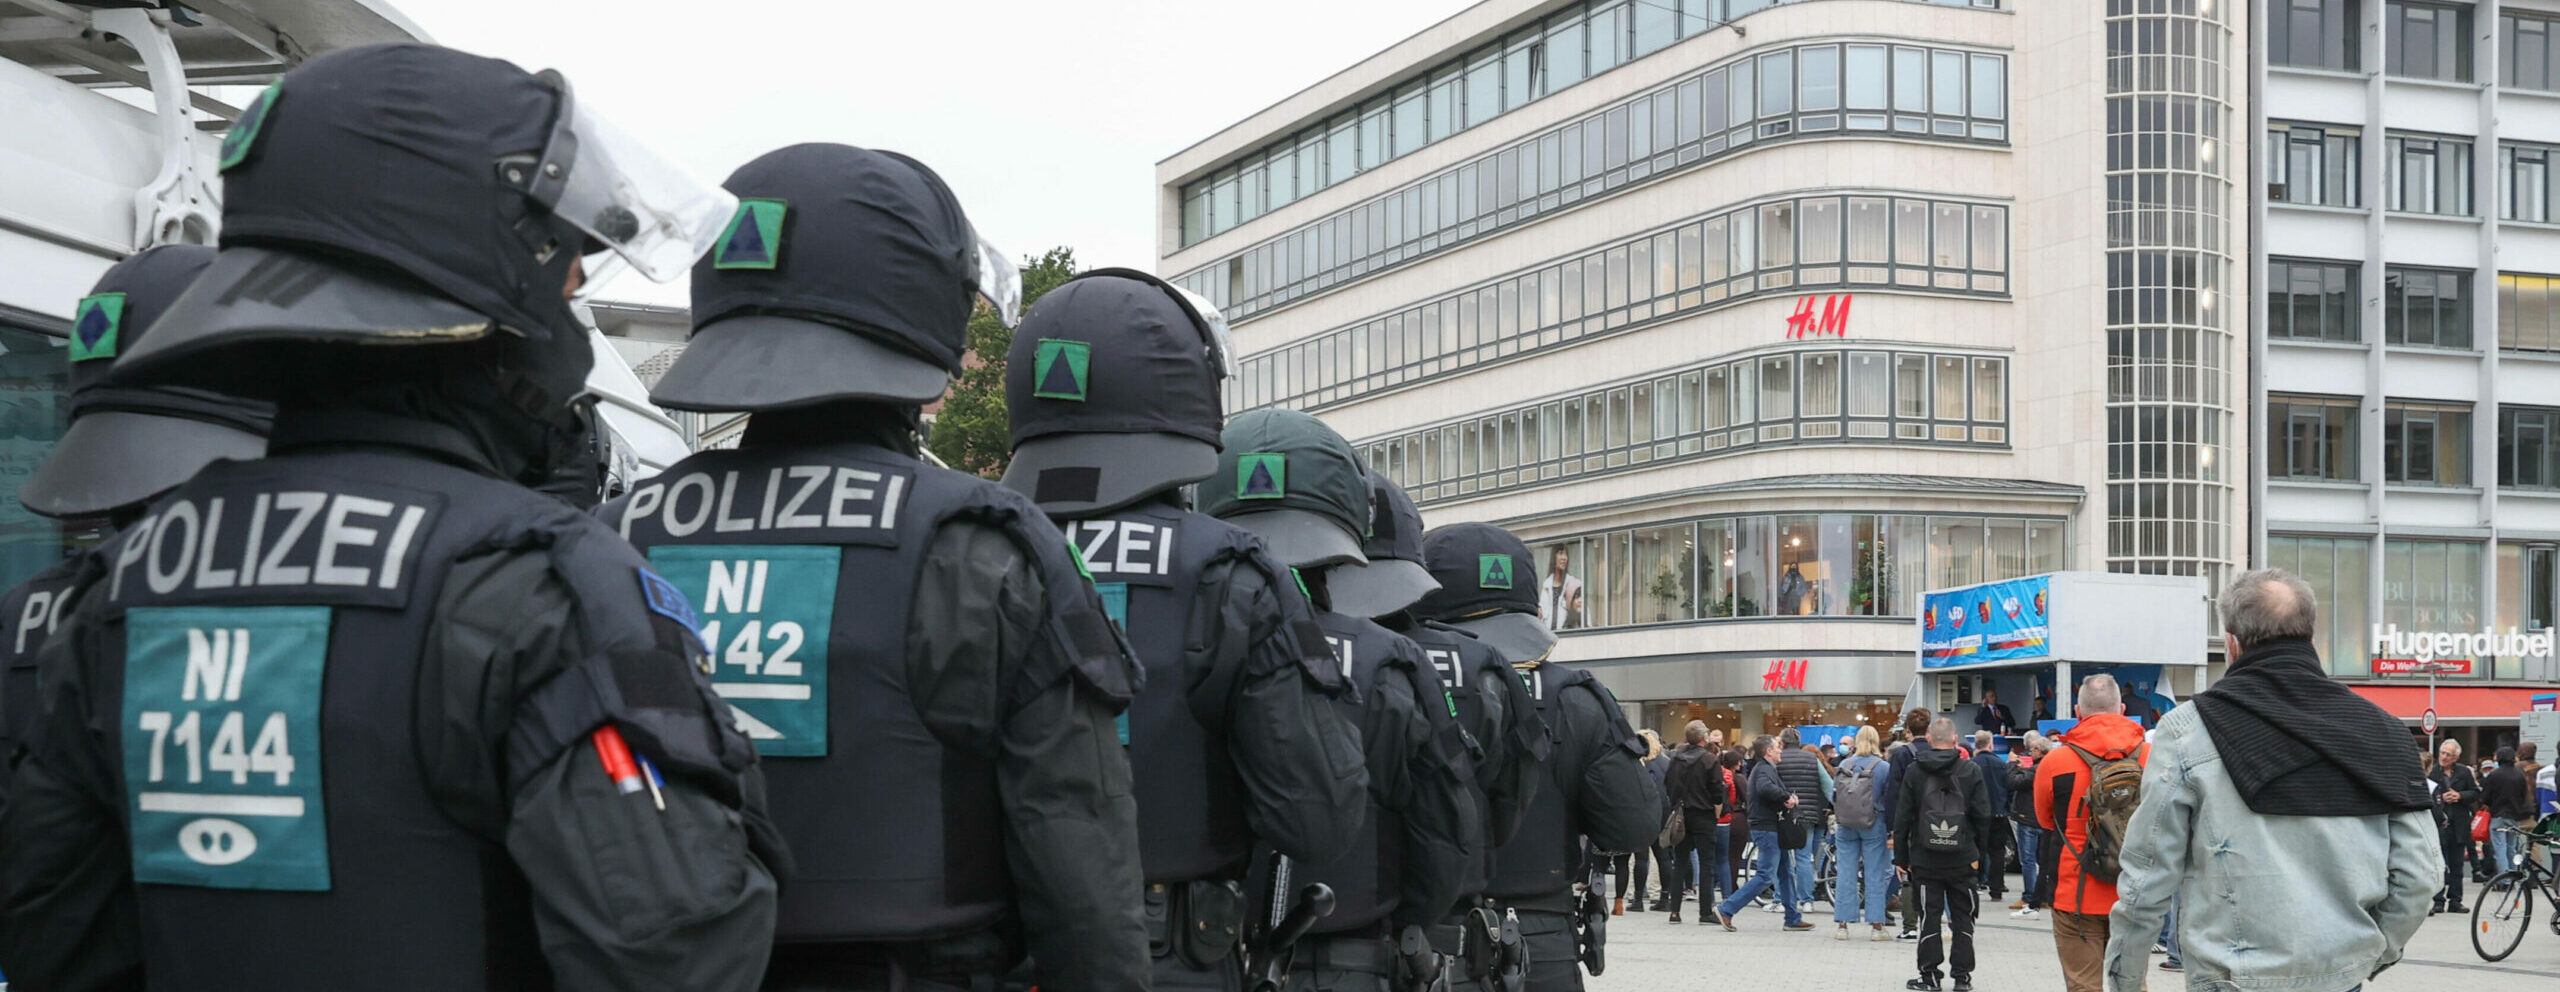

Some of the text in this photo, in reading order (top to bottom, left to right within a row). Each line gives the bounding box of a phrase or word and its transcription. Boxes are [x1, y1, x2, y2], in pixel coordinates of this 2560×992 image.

[1786, 294, 1853, 339] H&M
[619, 466, 905, 542] POLIZEI
[110, 492, 425, 600] POLIZEI
[704, 560, 769, 613] NI
[182, 629, 250, 701] NI
[2372, 624, 2554, 663] Hugendubel
[2380, 661, 2395, 671] Die
[1763, 660, 1808, 691] H&M
[140, 711, 295, 786] 7144
[1929, 838, 1958, 846] adidas
